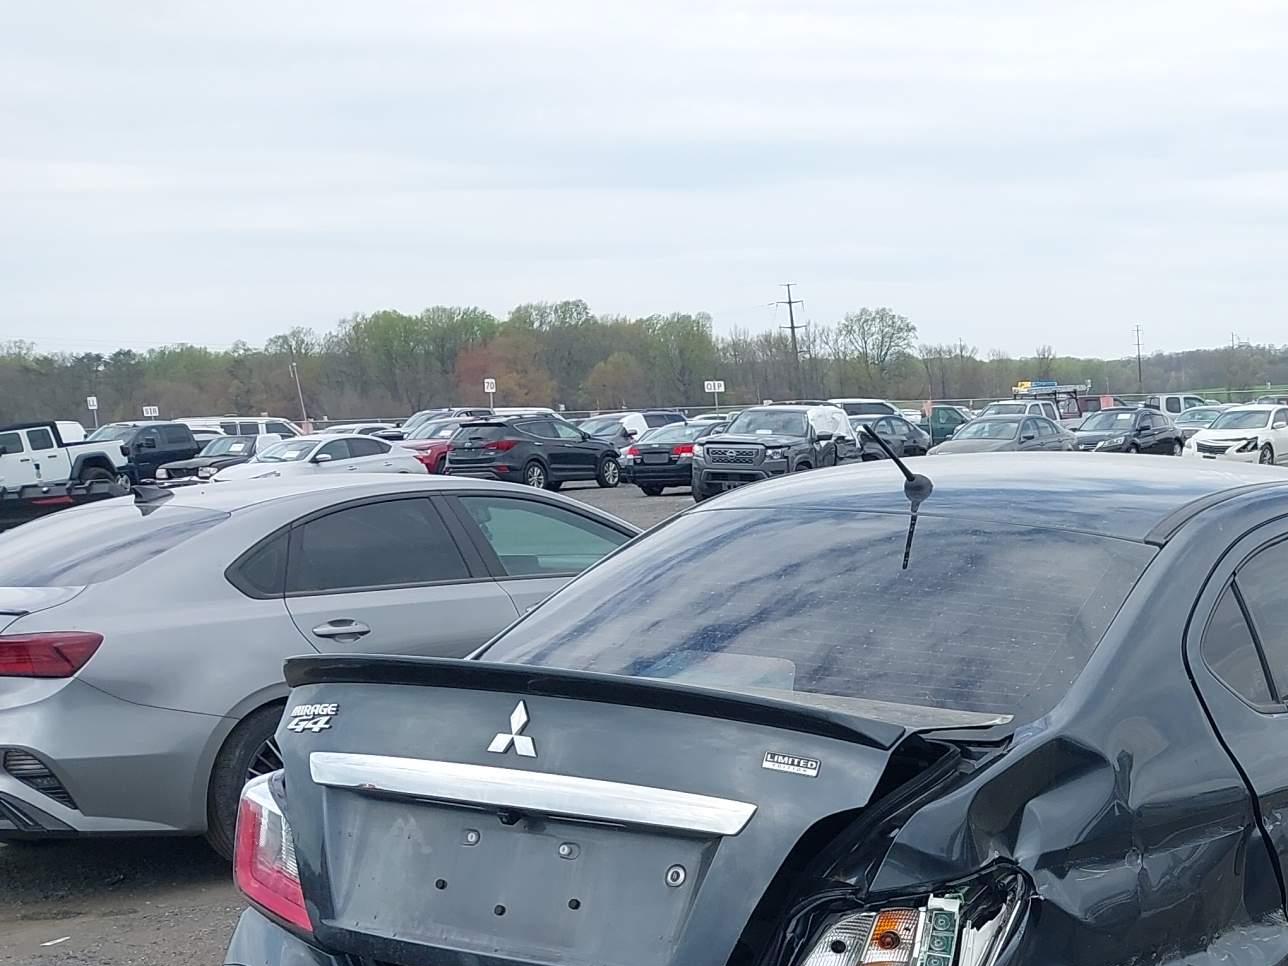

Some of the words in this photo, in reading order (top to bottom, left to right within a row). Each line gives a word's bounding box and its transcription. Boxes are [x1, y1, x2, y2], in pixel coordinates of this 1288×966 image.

[485, 381, 495, 390] 70
[289, 703, 338, 717] MIRAGE
[287, 715, 331, 733] G4
[766, 753, 818, 769] LIMITED
